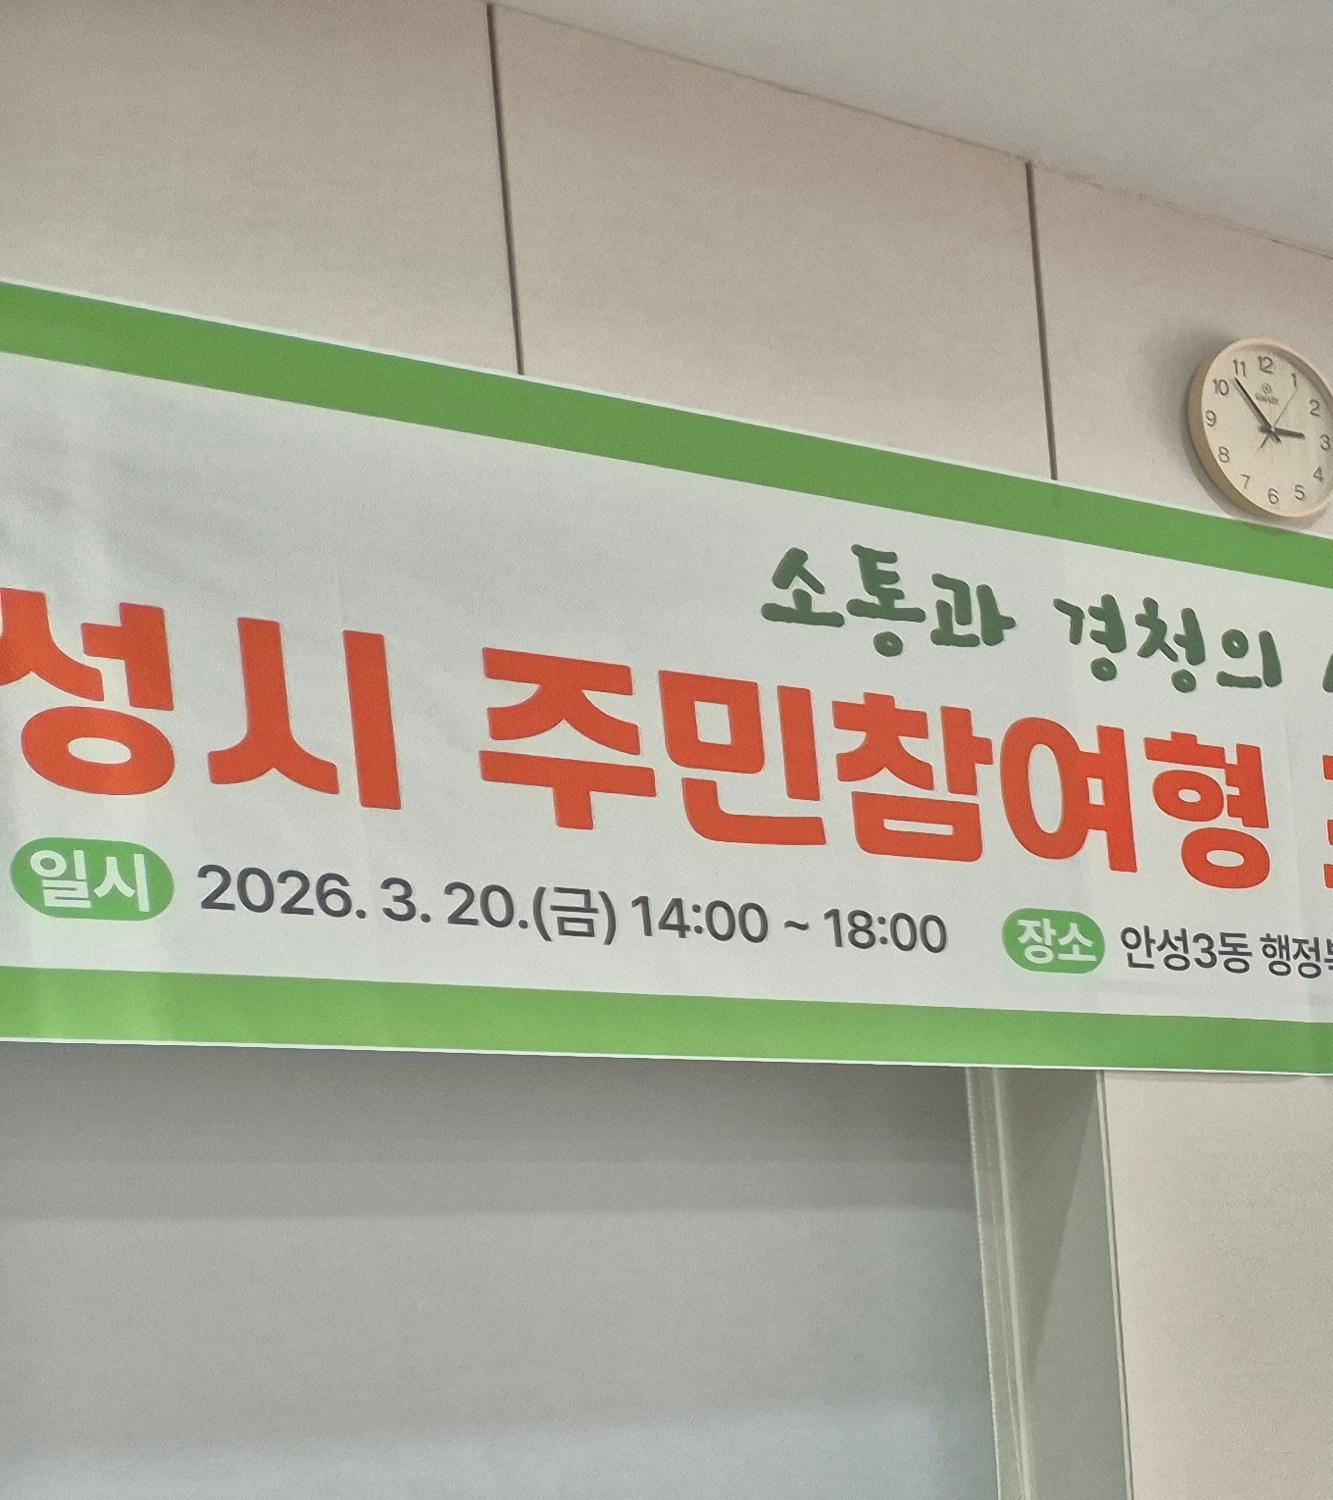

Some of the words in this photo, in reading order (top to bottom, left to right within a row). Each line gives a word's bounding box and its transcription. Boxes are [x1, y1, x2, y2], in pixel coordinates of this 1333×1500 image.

[1232, 359, 1247, 378] 11
[1257, 355, 1275, 375] 12
[1213, 378, 1230, 396] 10
[1291, 372, 1298, 388] 1
[1309, 398, 1321, 418] 2
[1204, 410, 1217, 427] 9
[1319, 434, 1332, 451] 3
[1218, 446, 1231, 464] 8
[1240, 473, 1251, 490] 7
[1312, 466, 1325, 483] 4
[1267, 488, 1280, 505] 6
[1294, 484, 1306, 501] 5
[761, 544, 1017, 658] 소통과
[1054, 594, 1283, 694] 경청의
[480, 648, 1271, 890] 주민참여형
[30, 849, 150, 912] 일시
[632, 895, 769, 944] 14:00
[824, 908, 947, 954] 18:00
[1018, 918, 1097, 964] 장소
[1120, 925, 1253, 974] 안성3동
